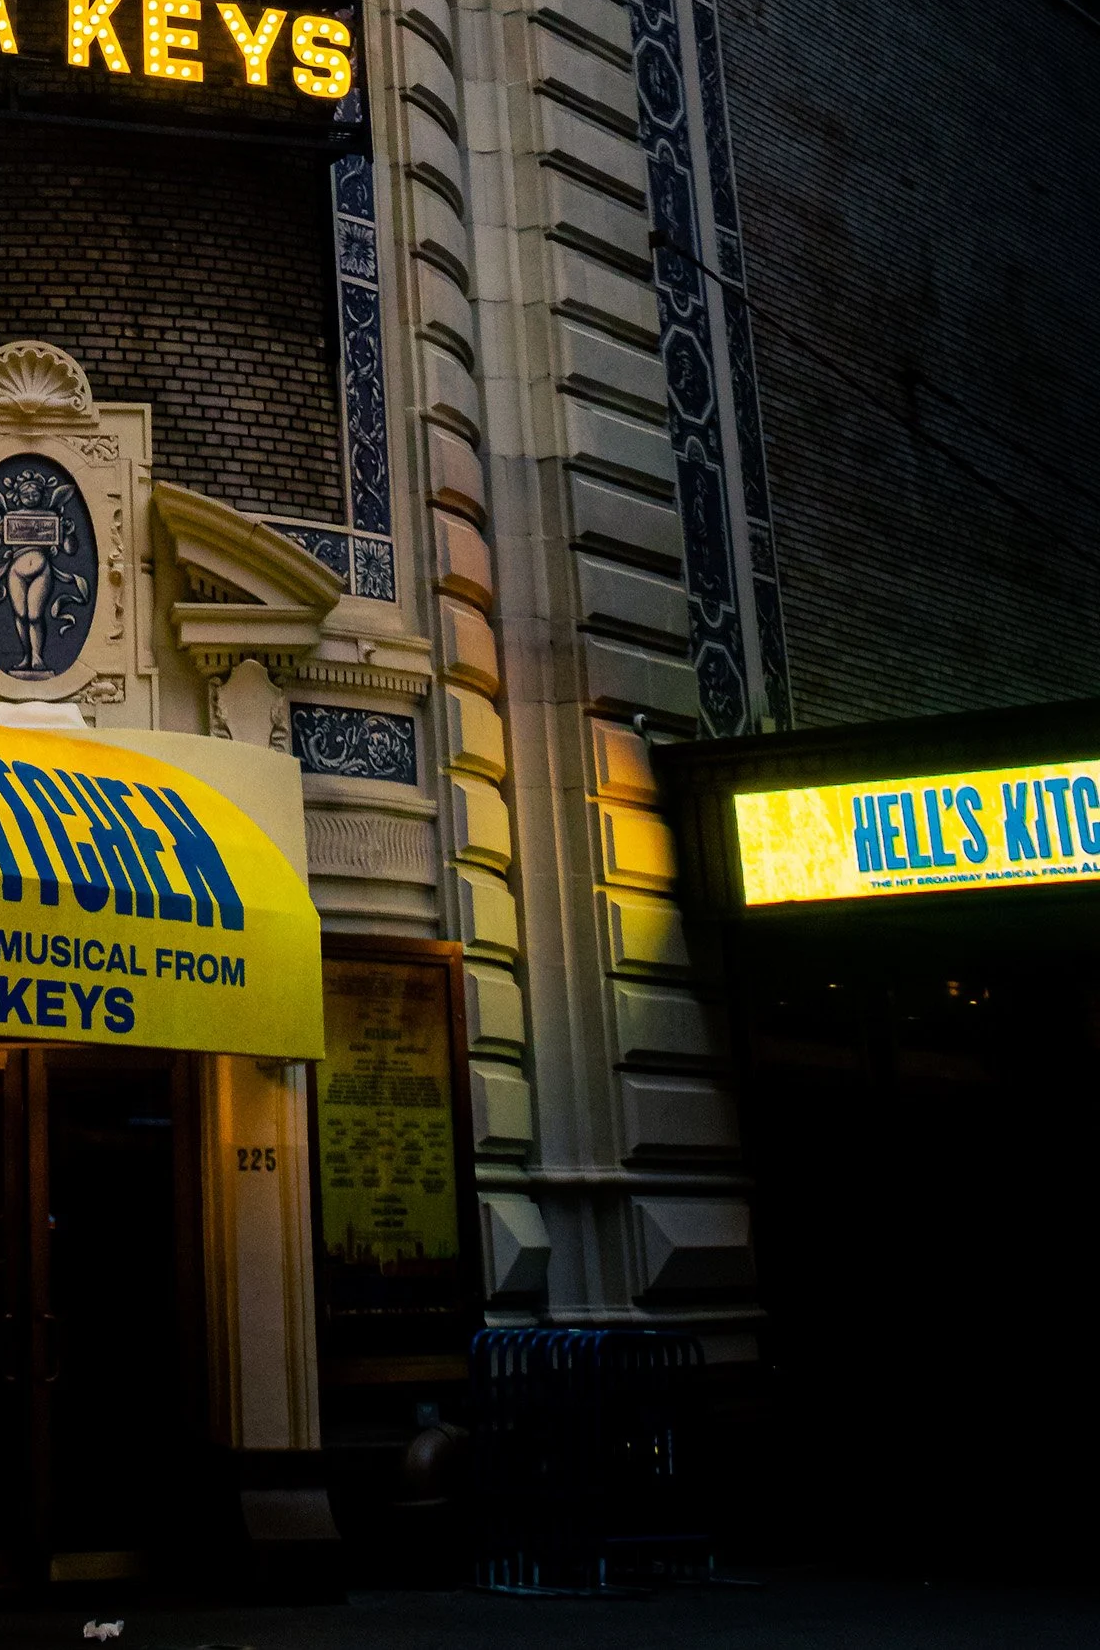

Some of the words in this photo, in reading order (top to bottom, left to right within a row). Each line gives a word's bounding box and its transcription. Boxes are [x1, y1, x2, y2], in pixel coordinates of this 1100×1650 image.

[853, 786, 988, 873] HELL'S
[870, 878, 892, 889] THE
[895, 876, 914, 887] HIT
[917, 872, 982, 885] BROADWAY
[986, 868, 1039, 880] MUSICAL
[1042, 865, 1078, 875] FROM
[156, 948, 246, 987] FROM
[237, 1149, 276, 1172] 225
